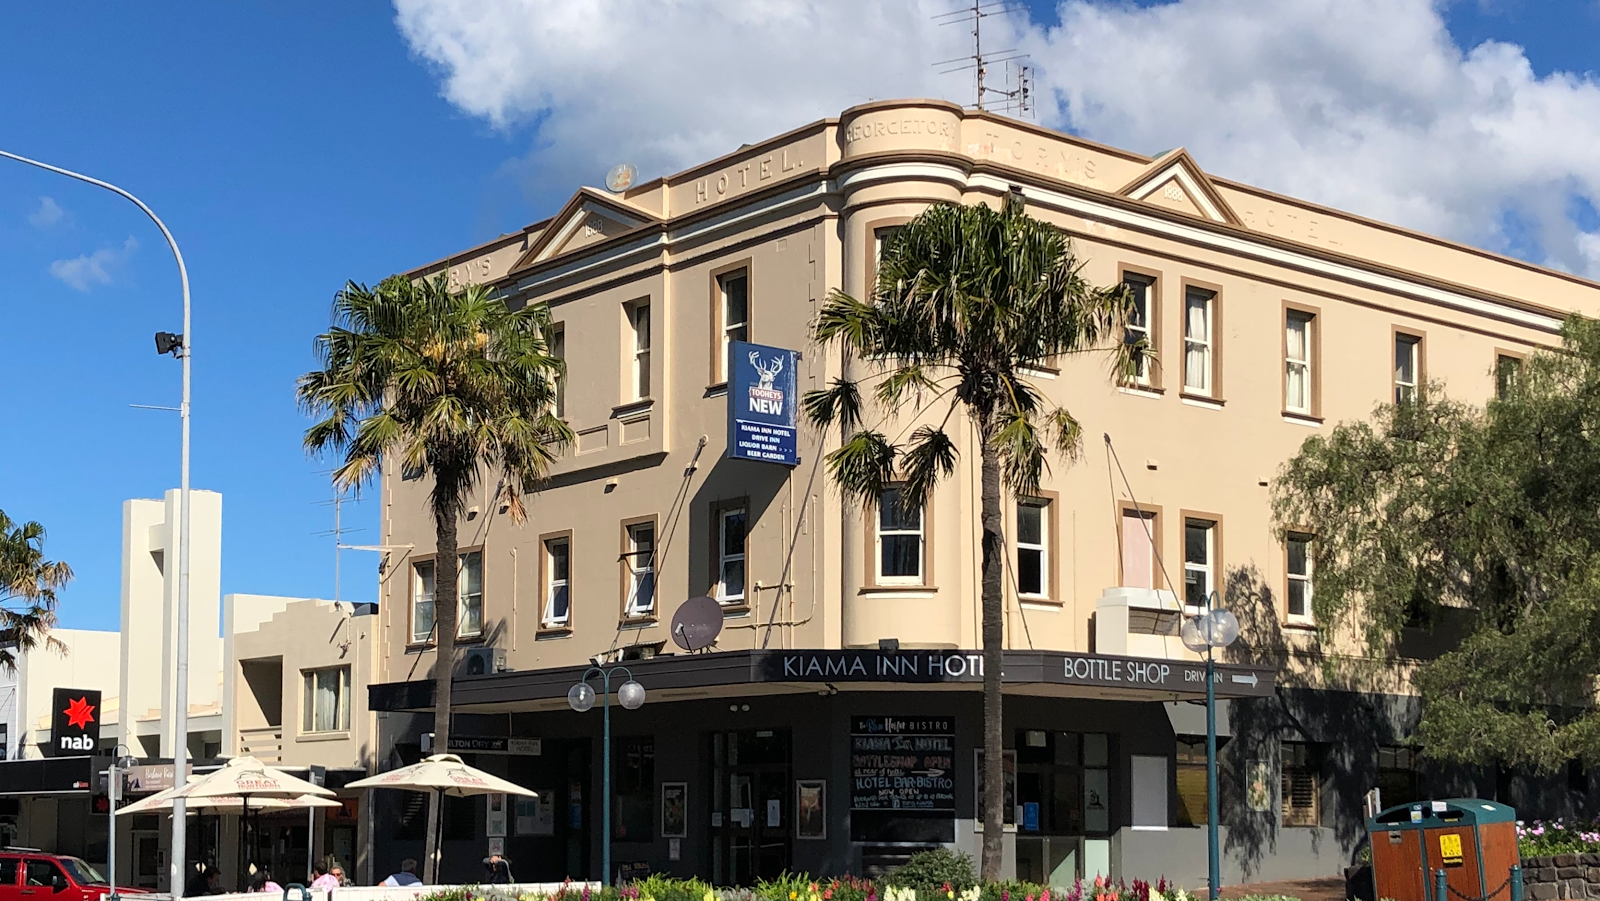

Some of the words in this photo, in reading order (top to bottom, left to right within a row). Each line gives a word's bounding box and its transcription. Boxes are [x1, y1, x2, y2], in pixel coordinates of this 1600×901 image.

[1163, 184, 1183, 202] 1888
[585, 219, 603, 238] 1888
[751, 388, 781, 400] TOOHEYS
[749, 398, 782, 415] NEW
[741, 424, 760, 433] KIAMA
[761, 427, 772, 435] INN
[772, 428, 791, 437] HOTEL
[751, 433, 769, 442] DRIVE
[739, 440, 760, 449] LIQUOR
[761, 443, 777, 451] BARN
[762, 451, 785, 460] GARDEN
[784, 655, 867, 677] KIAMA
[876, 655, 918, 676] INN
[928, 654, 1005, 678] HOT
[1064, 657, 1122, 681] BOTTLE
[1126, 658, 1170, 684] SHOP
[1184, 669, 1206, 683] DRIV
[910, 722, 948, 730] BISTRO
[60, 734, 94, 751] nab
[471, 740, 490, 748] DRY
[856, 776, 891, 790] HOTEL
[898, 788, 920, 796] OPEN
